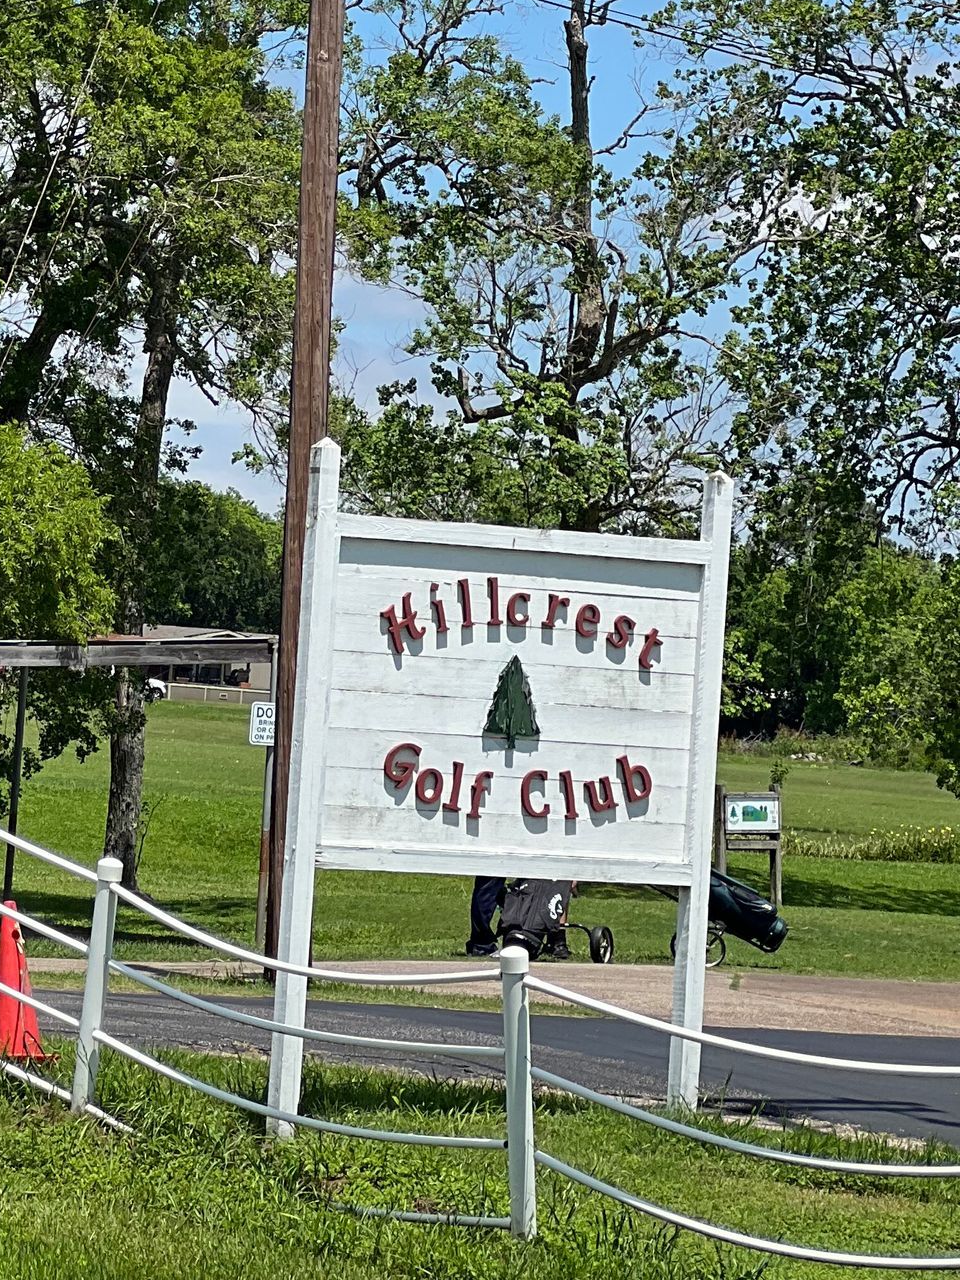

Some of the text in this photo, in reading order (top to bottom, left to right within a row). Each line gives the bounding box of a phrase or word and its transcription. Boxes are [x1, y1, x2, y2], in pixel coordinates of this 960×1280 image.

[380, 577, 663, 669] Hillcrest
[384, 742, 652, 820] Golf Club
